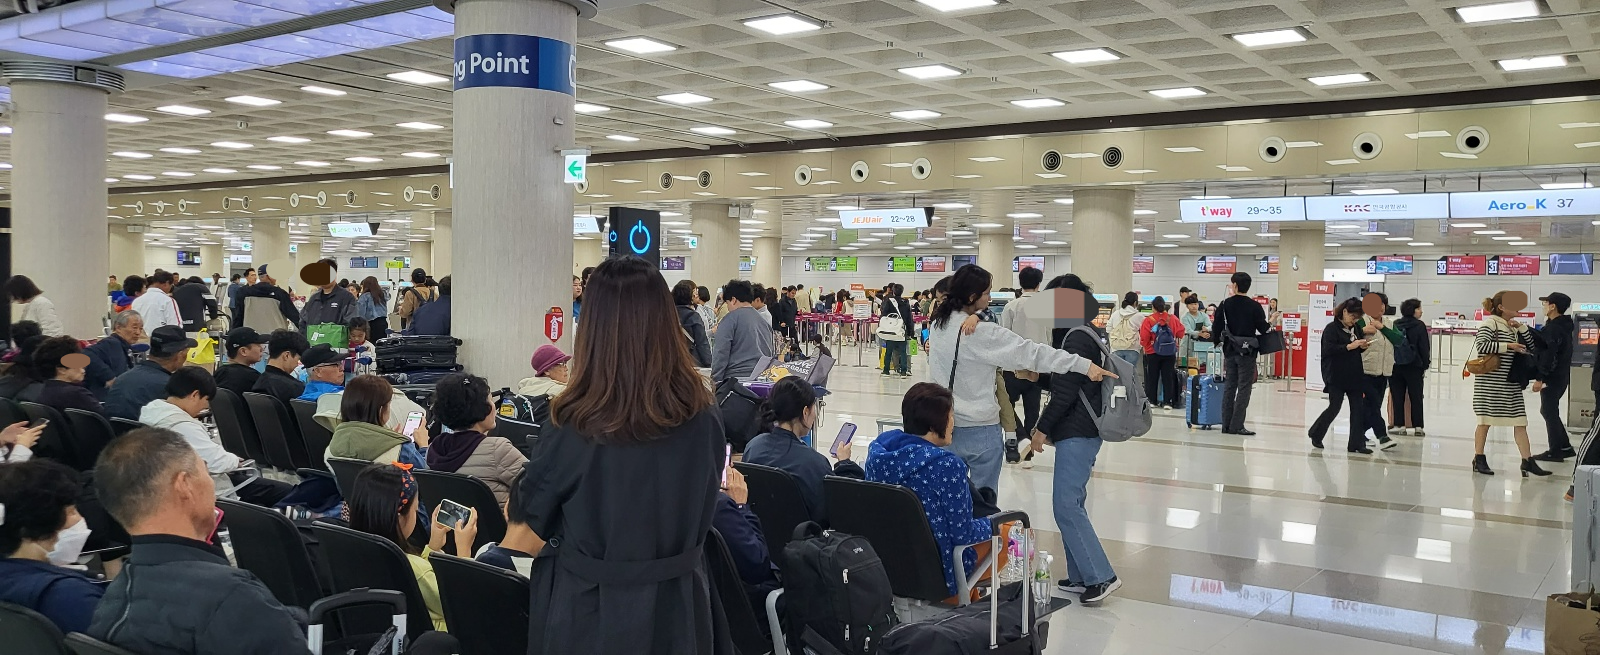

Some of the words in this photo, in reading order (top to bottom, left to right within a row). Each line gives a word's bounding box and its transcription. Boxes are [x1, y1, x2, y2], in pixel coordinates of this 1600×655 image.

[470, 51, 530, 75] Point
[1556, 198, 1574, 208] 37
[1201, 206, 1232, 218] t'way
[1247, 206, 1282, 215] 29~35
[1344, 204, 1371, 213] KAC
[890, 215, 916, 223] 22~28
[1198, 262, 1205, 270] 27
[1437, 263, 1446, 271] 30
[1489, 263, 1498, 271] 31
[1316, 284, 1328, 292] tway
[790, 365, 810, 375] GRASS
